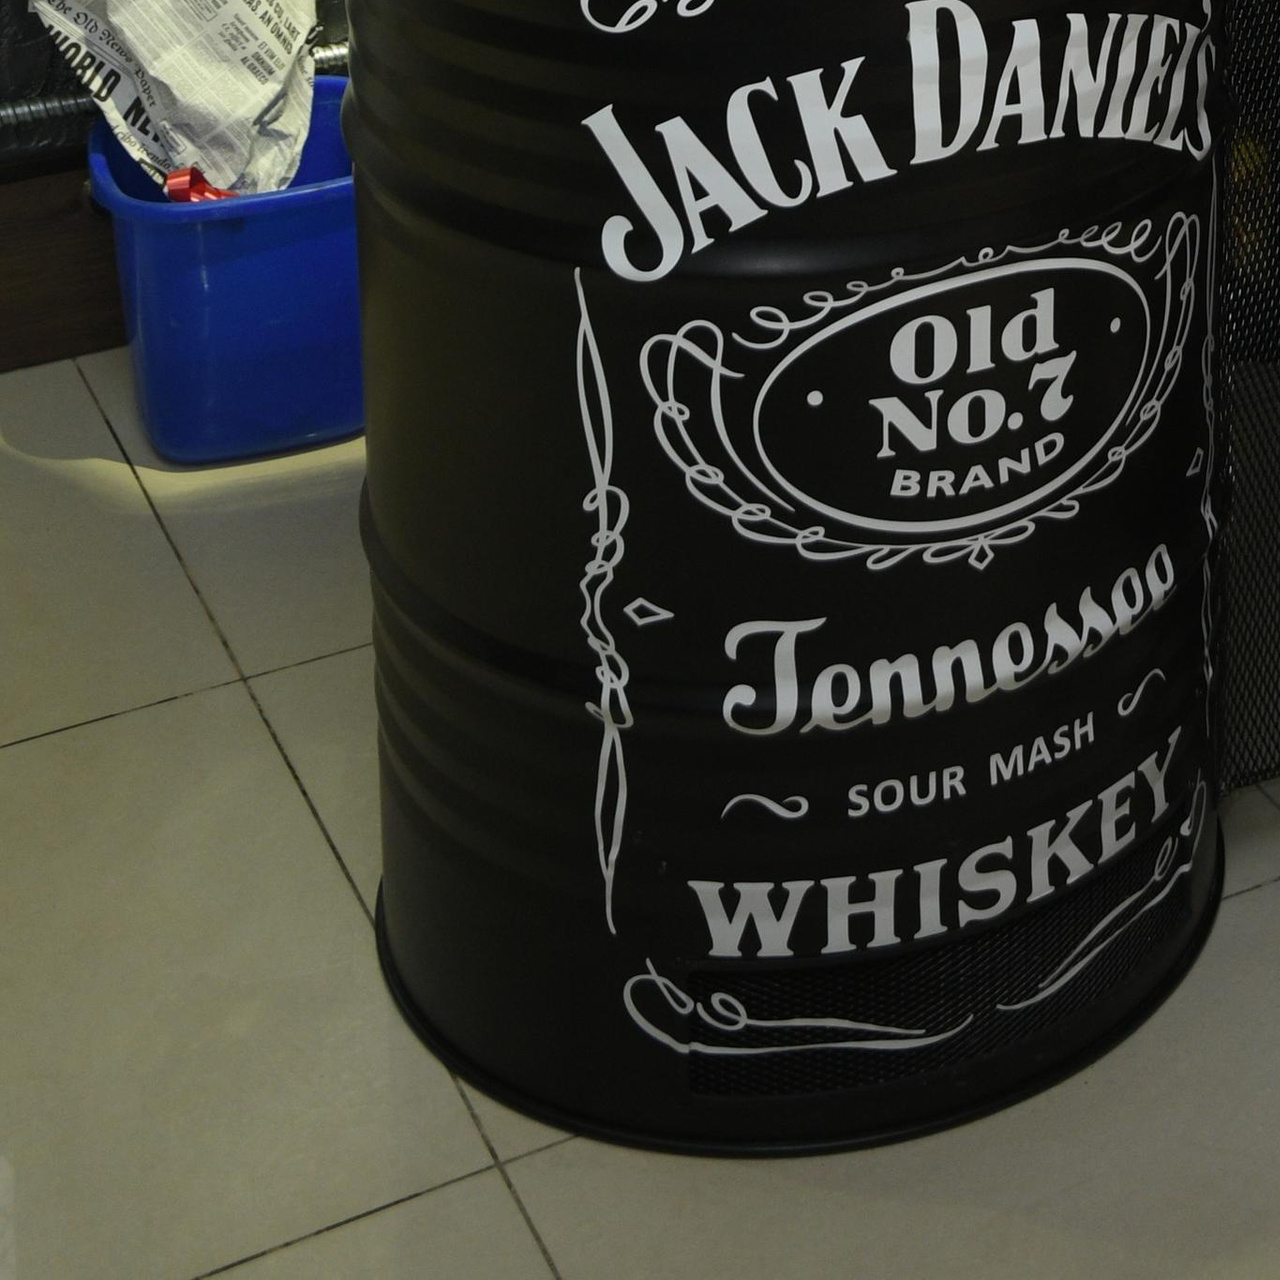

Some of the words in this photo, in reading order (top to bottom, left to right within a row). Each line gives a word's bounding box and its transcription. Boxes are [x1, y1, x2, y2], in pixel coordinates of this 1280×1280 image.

[73, 11, 99, 34] Old
[99, 28, 133, 64] News
[134, 63, 158, 109] Paper
[259, 10, 274, 28] AN
[581, 55, 898, 282] JACK
[890, 287, 1060, 385] Old
[889, 432, 1066, 499] BRAND
[722, 543, 1178, 735] Tennessee
[847, 765, 967, 818] SOUR
[989, 711, 1096, 786] MASH
[687, 726, 1182, 957] WHISKEY
